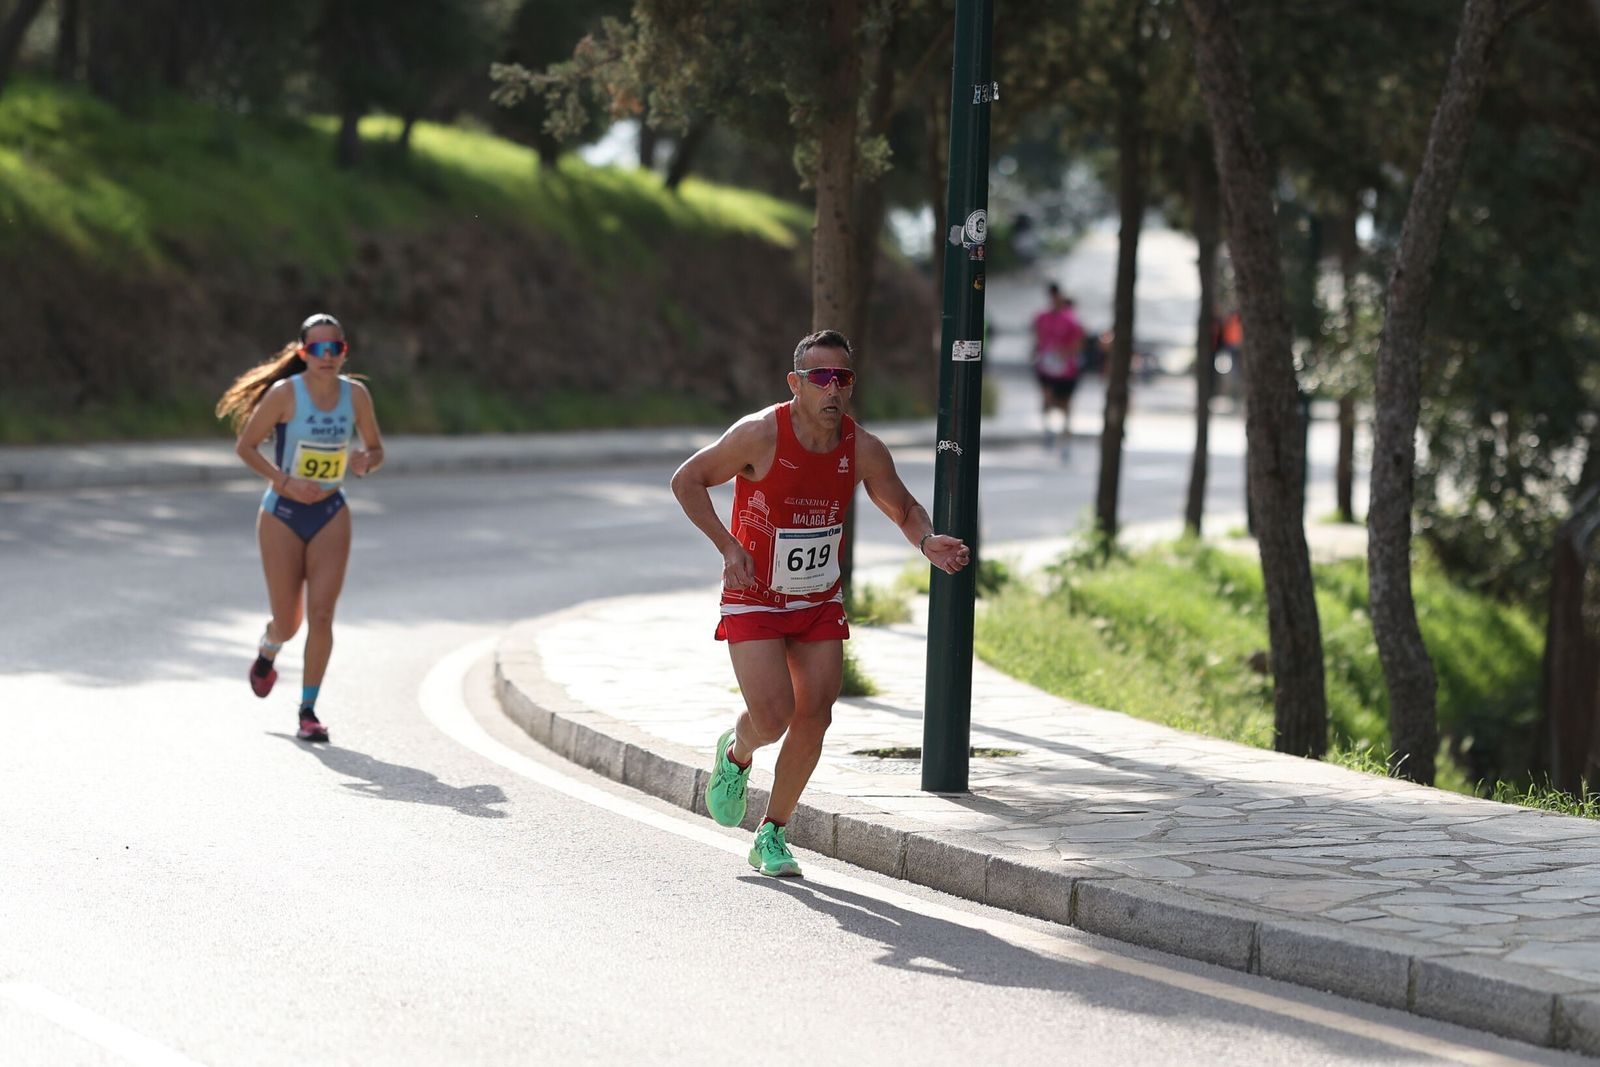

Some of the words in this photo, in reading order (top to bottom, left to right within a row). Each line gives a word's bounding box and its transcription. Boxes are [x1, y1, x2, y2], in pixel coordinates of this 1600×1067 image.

[303, 459, 340, 478] 921
[793, 512, 826, 526] MÁLAGA
[787, 544, 831, 572] 619
